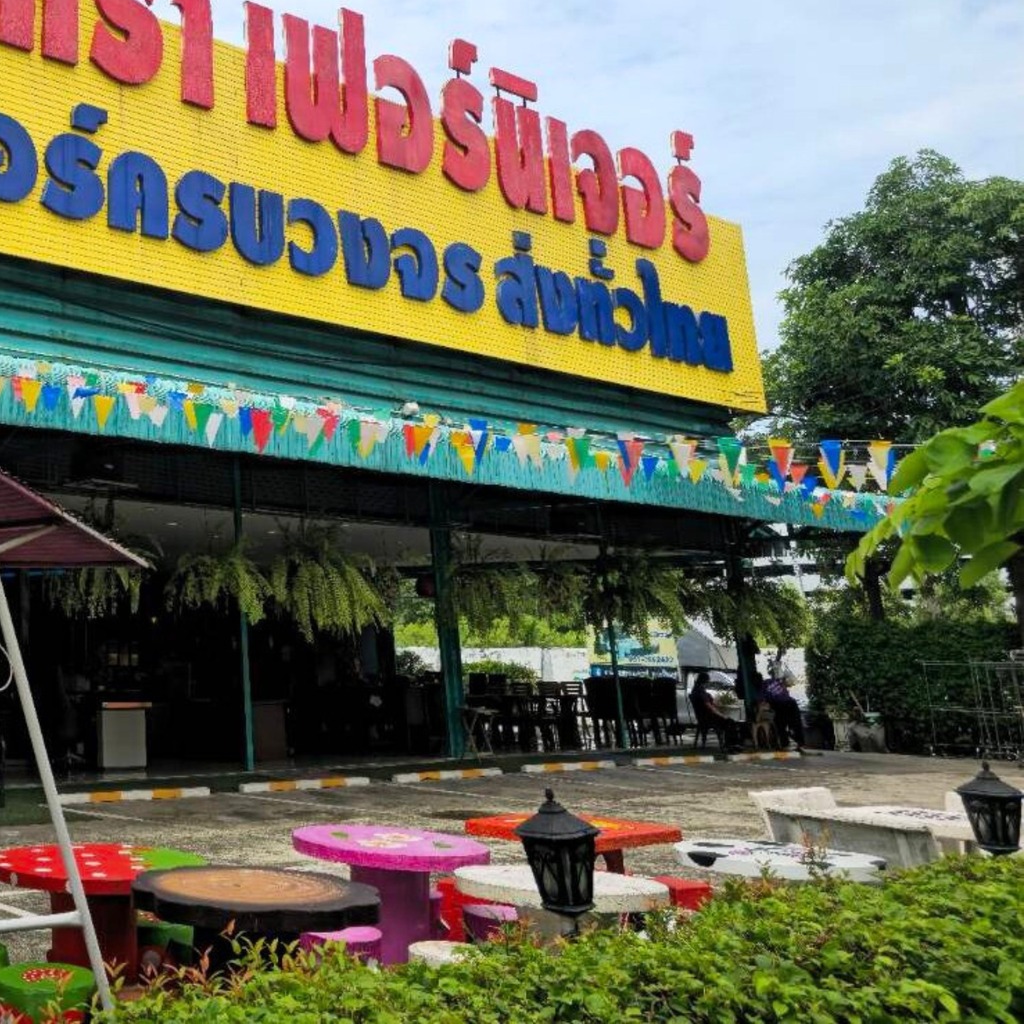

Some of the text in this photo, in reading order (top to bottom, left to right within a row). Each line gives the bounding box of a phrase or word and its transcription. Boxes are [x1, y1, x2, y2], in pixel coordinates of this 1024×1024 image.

[243, 0, 711, 263] เฟอร์นิเจอร์
